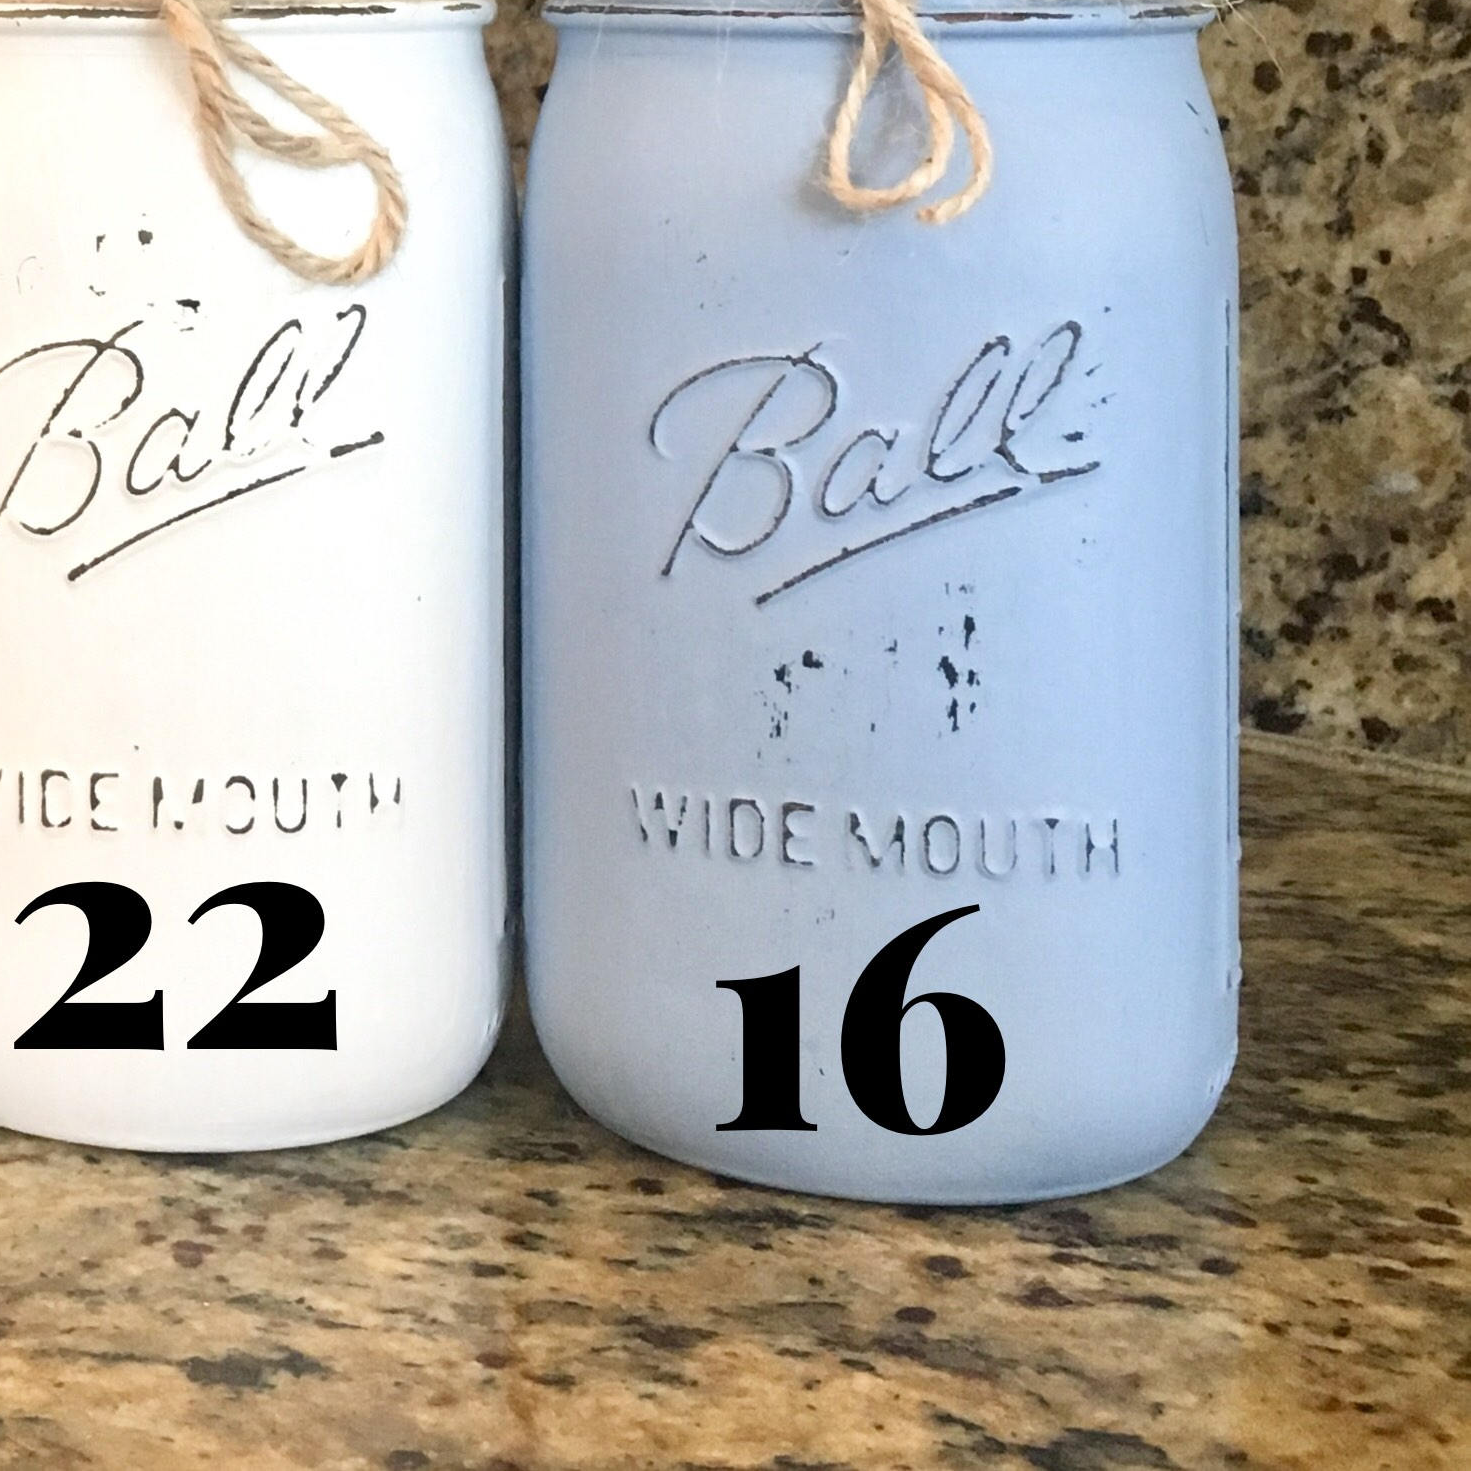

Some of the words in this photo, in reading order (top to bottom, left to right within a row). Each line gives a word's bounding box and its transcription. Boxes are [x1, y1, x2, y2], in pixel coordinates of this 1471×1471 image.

[649, 319, 1101, 602] Ball
[630, 786, 817, 867] WIDE
[848, 814, 1122, 879] MOUTH
